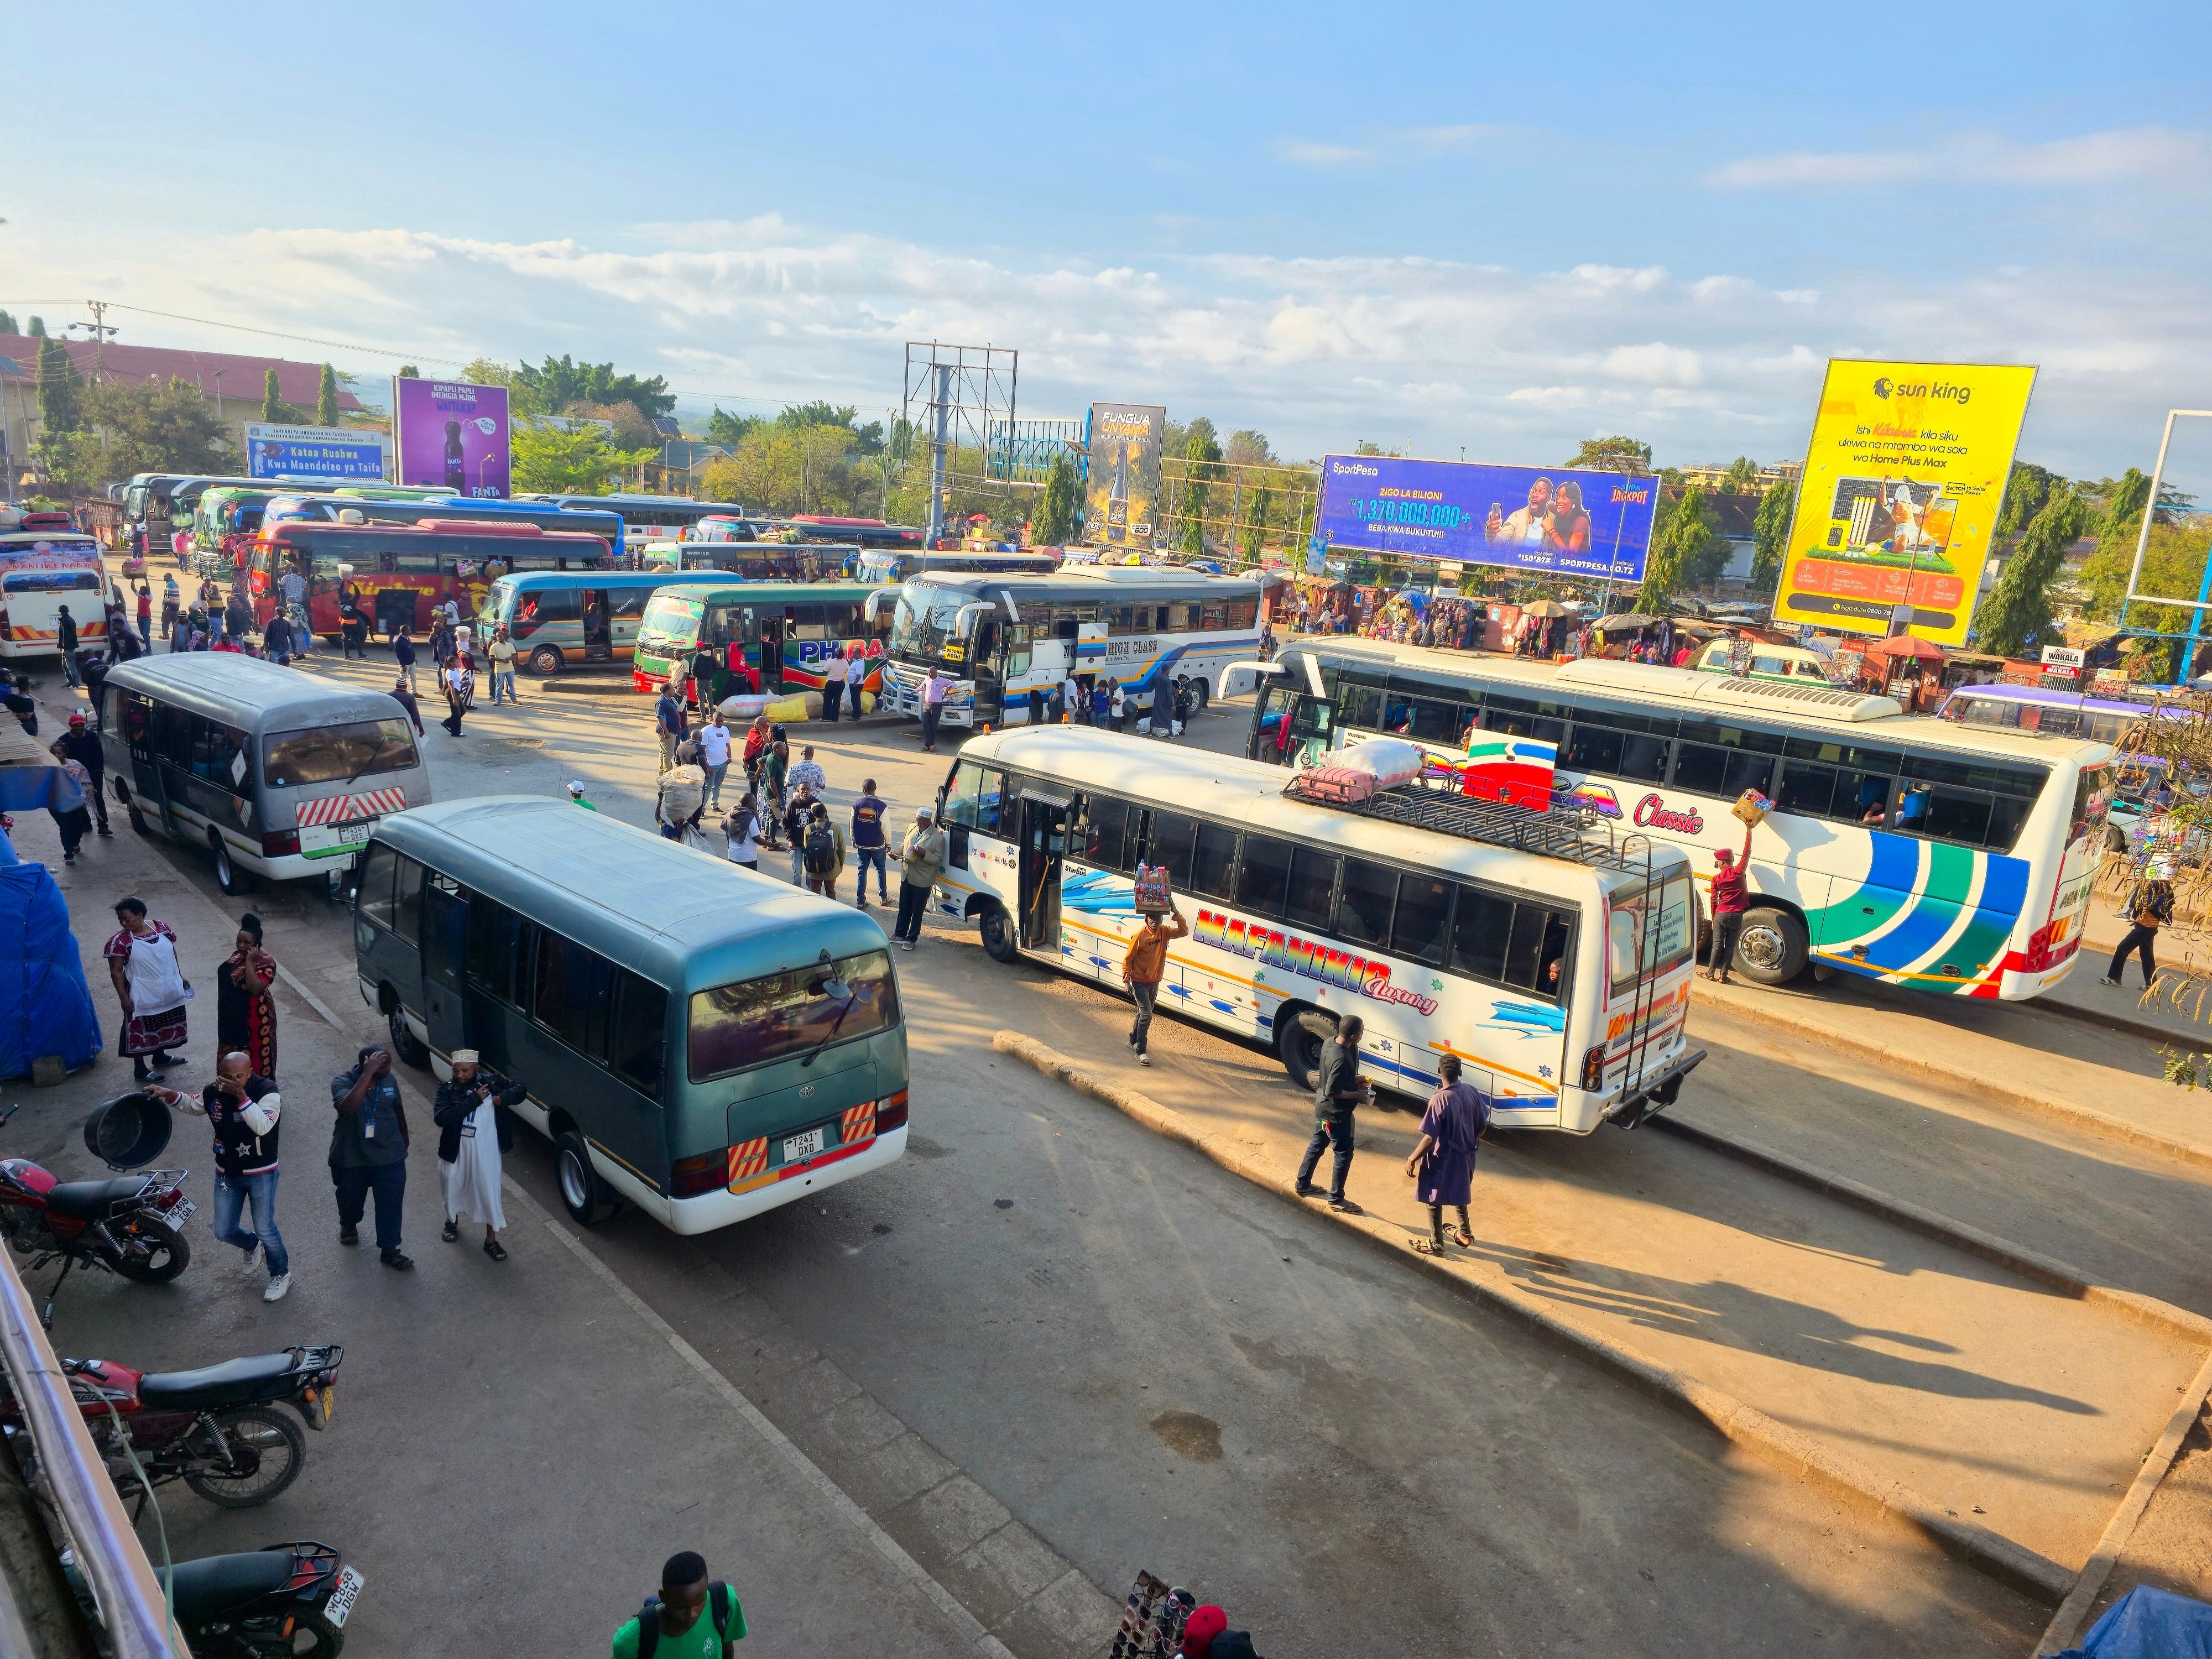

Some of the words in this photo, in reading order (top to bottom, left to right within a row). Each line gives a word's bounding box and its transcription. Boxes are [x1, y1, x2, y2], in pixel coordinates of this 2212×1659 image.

[434, 384, 457, 393] KIPAPLI
[1896, 383, 1927, 398] sun
[1931, 382, 1971, 405] king
[431, 391, 458, 400] IMEINGIA
[459, 394, 477, 402] MJINI.
[437, 401, 476, 414] WAITAKA?
[481, 419, 494, 428] Fleva
[1102, 411, 1150, 425] FUNGUA
[1102, 422, 1149, 435] UNYAMA
[1856, 425, 1872, 435] Ishi
[1873, 422, 1917, 438] Kikubwa
[1920, 429, 1938, 440] kila
[1939, 431, 1958, 441] siku
[291, 447, 319, 457] Kataa
[322, 448, 358, 459] Rushwa
[1839, 438, 1867, 448] ukiwa
[1882, 441, 1927, 452] mtambo
[1947, 445, 1968, 455] sola
[268, 459, 286, 469] Kwa
[290, 460, 341, 471] Maendeleo
[345, 465, 354, 473] ya
[358, 463, 380, 472] Taifa
[1870, 453, 1900, 465] Home
[1901, 456, 1921, 466] Plus
[1923, 457, 1948, 468] Max
[1333, 462, 1378, 476] SportPesa
[472, 486, 500, 498] FANTA
[1380, 488, 1399, 497] ZIGO
[1401, 489, 1411, 498] LA
[1412, 490, 1442, 500] BILIONI
[1369, 524, 1386, 532] BEBA
[1387, 525, 1404, 534] KWA
[1406, 527, 1425, 536] BUKU
[1426, 529, 1444, 538] TU!!!
[615, 597, 634, 613] Welcome
[799, 639, 884, 662] PHIBA
[1108, 642, 1130, 655] HIGH
[1133, 640, 1157, 654] CLASS
[2048, 653, 2078, 662] WAKALA
[1634, 794, 1704, 834] Classic
[1065, 864, 1087, 877] Starbus
[1663, 912, 1672, 922] 23:28
[1193, 908, 1391, 995] MAFANIKIO
[1364, 977, 1438, 1016] Luxury
[844, 1115, 875, 1129] COASTER
[794, 1133, 813, 1147] T241
[799, 1143, 814, 1157] DXD
[179, 1207, 193, 1221] EQA
[328, 1571, 353, 1613] MC838
[342, 1582, 359, 1610] DGW
